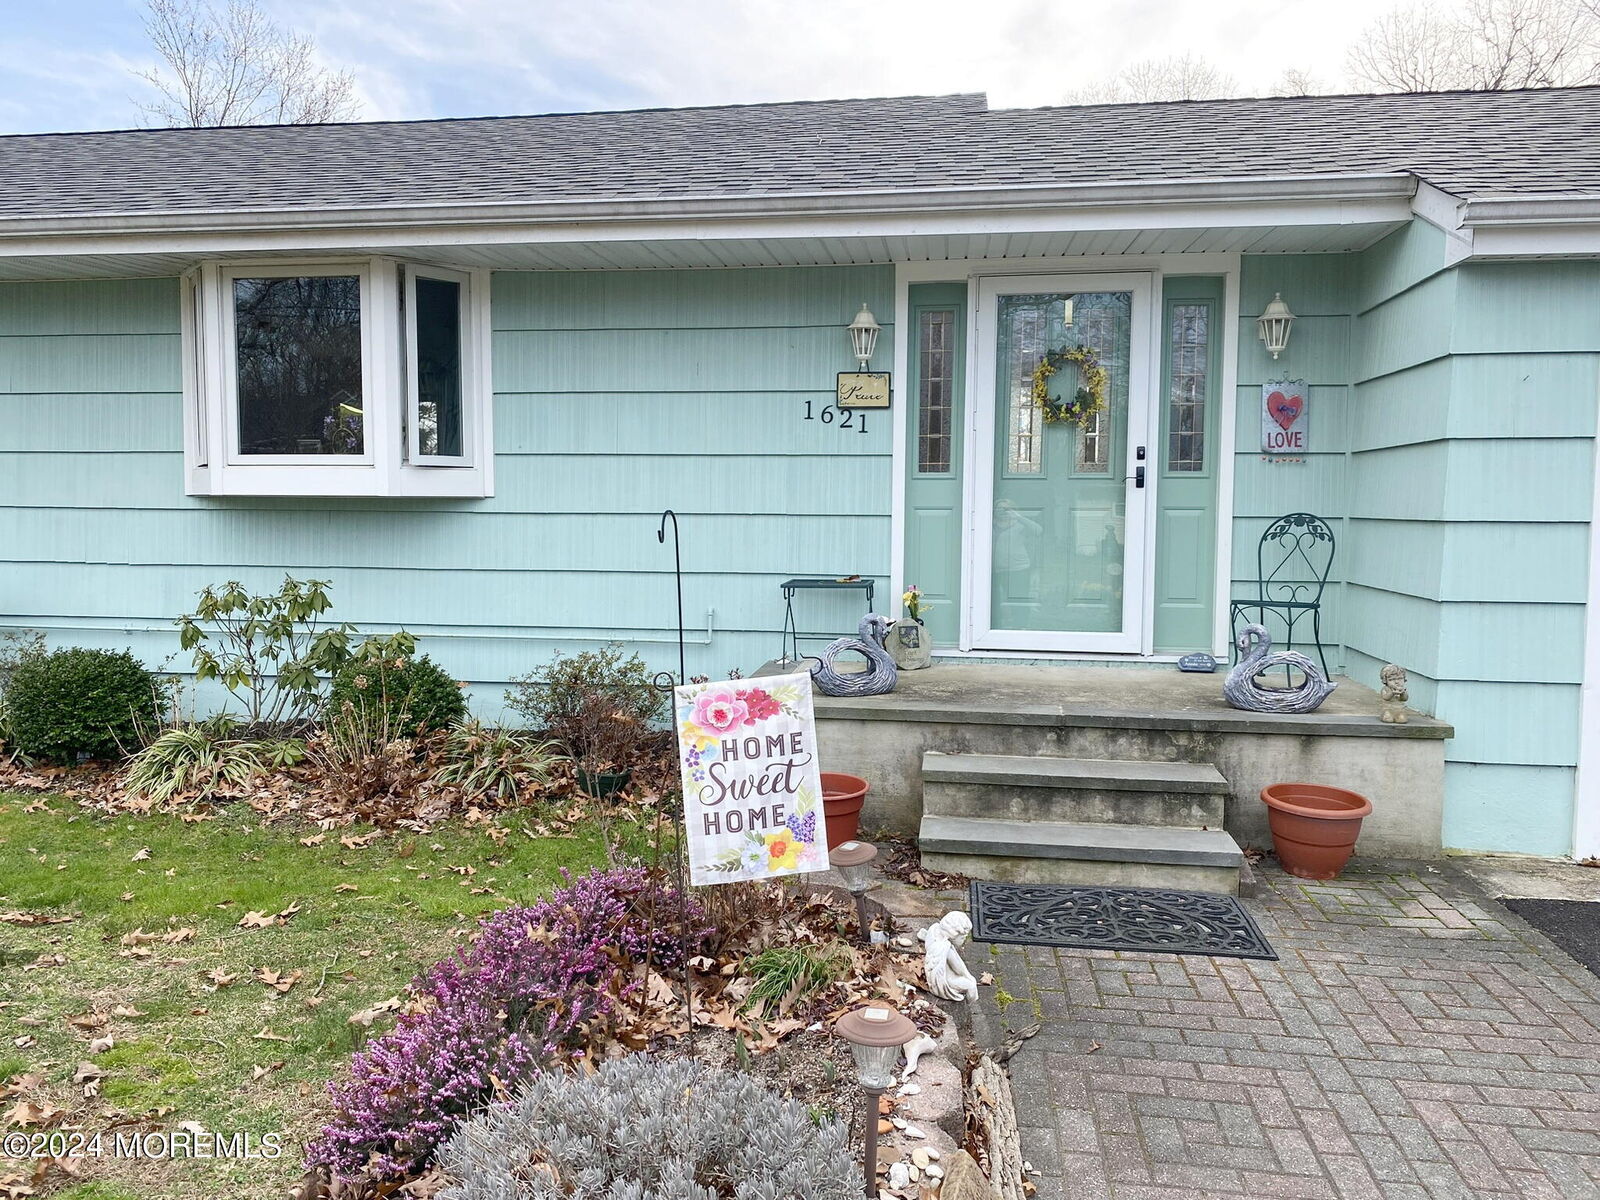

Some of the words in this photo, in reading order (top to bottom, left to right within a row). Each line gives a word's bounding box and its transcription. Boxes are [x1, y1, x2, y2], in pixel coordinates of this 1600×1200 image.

[804, 400, 868, 433] 1621
[1267, 431, 1303, 449] LOVE
[721, 731, 804, 762] HOME
[699, 752, 812, 806] Sweet
[703, 803, 786, 835] HOME
